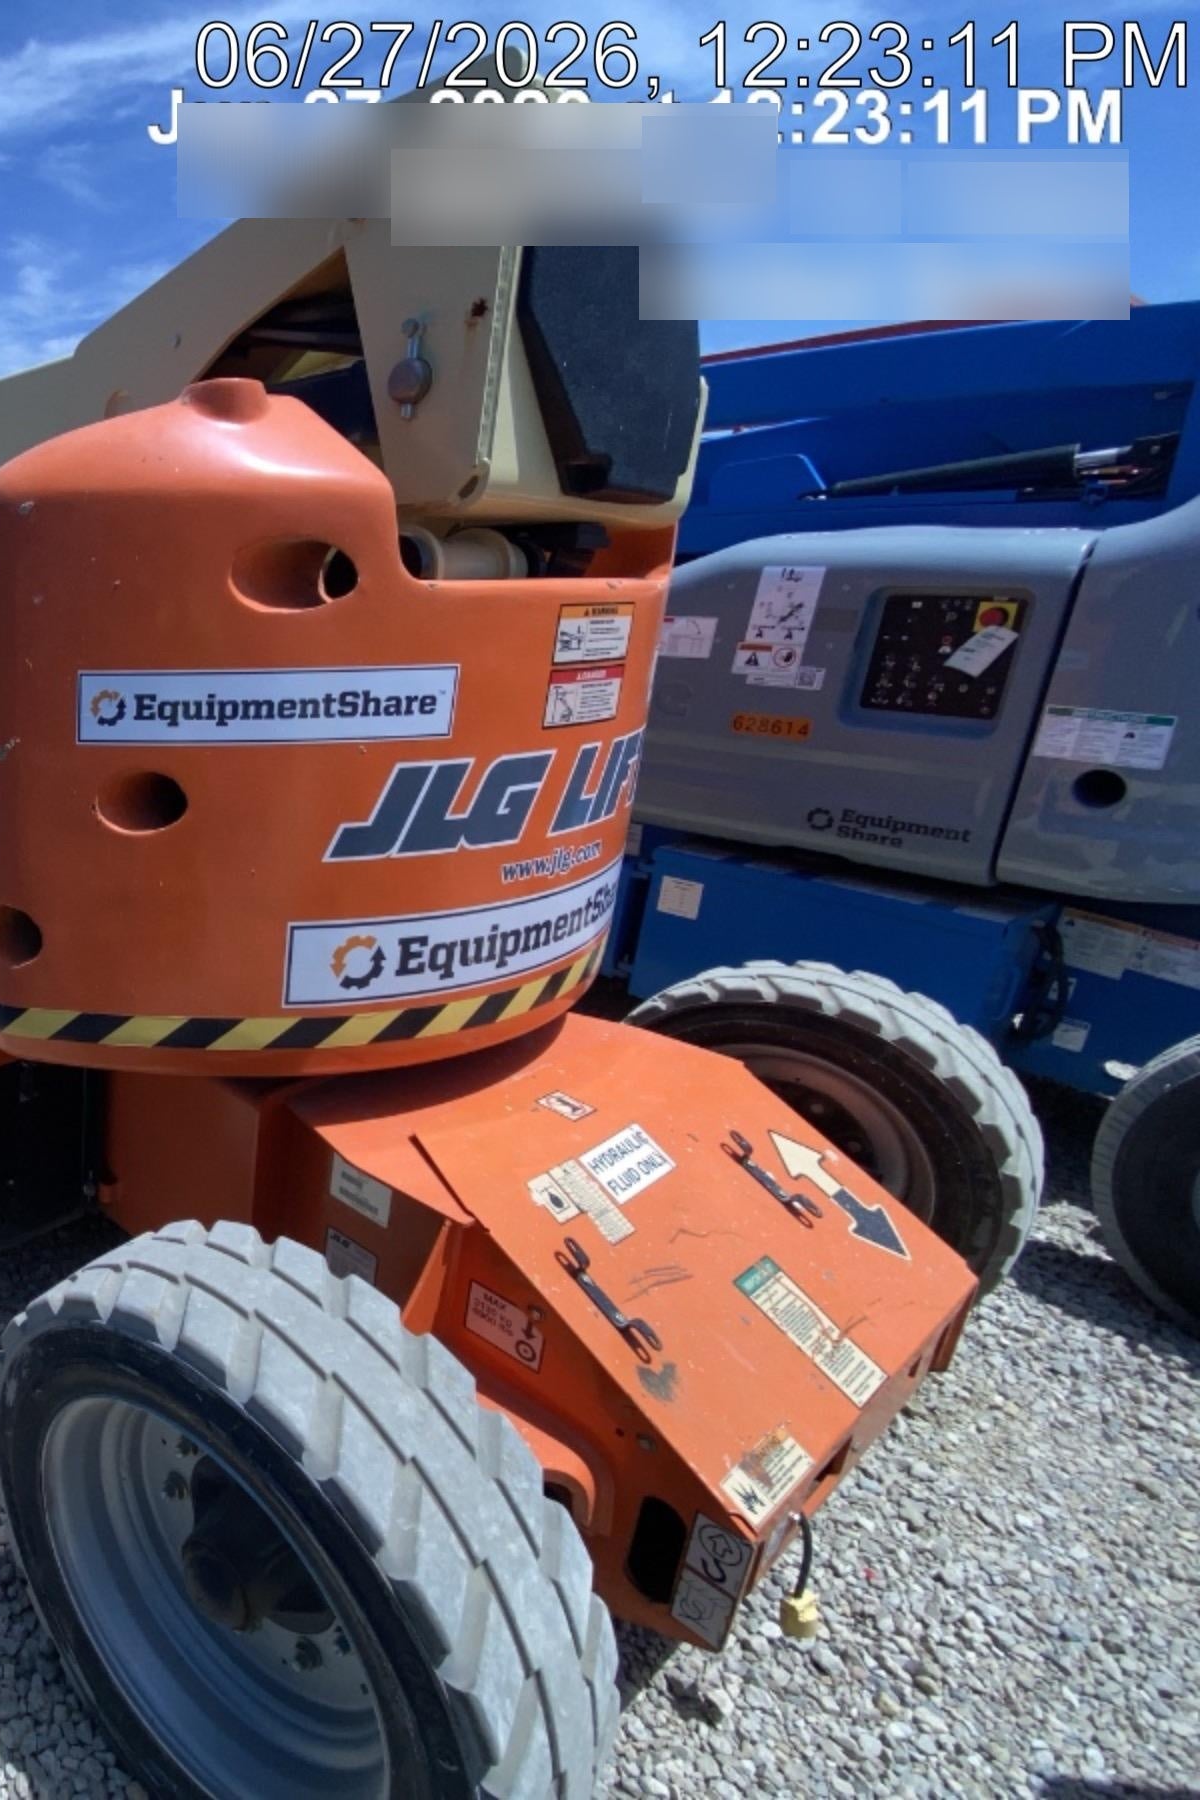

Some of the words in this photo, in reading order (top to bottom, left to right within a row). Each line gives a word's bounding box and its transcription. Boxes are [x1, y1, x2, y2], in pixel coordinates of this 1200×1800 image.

[133, 690, 437, 727] EquipmentShare
[323, 749, 556, 862] JLG
[836, 825, 903, 849] Share
[840, 808, 971, 843] Equipment
[502, 842, 602, 883] www.jlg.com
[607, 1167, 641, 1196] FLUID
[637, 1150, 668, 1175] ONLY
